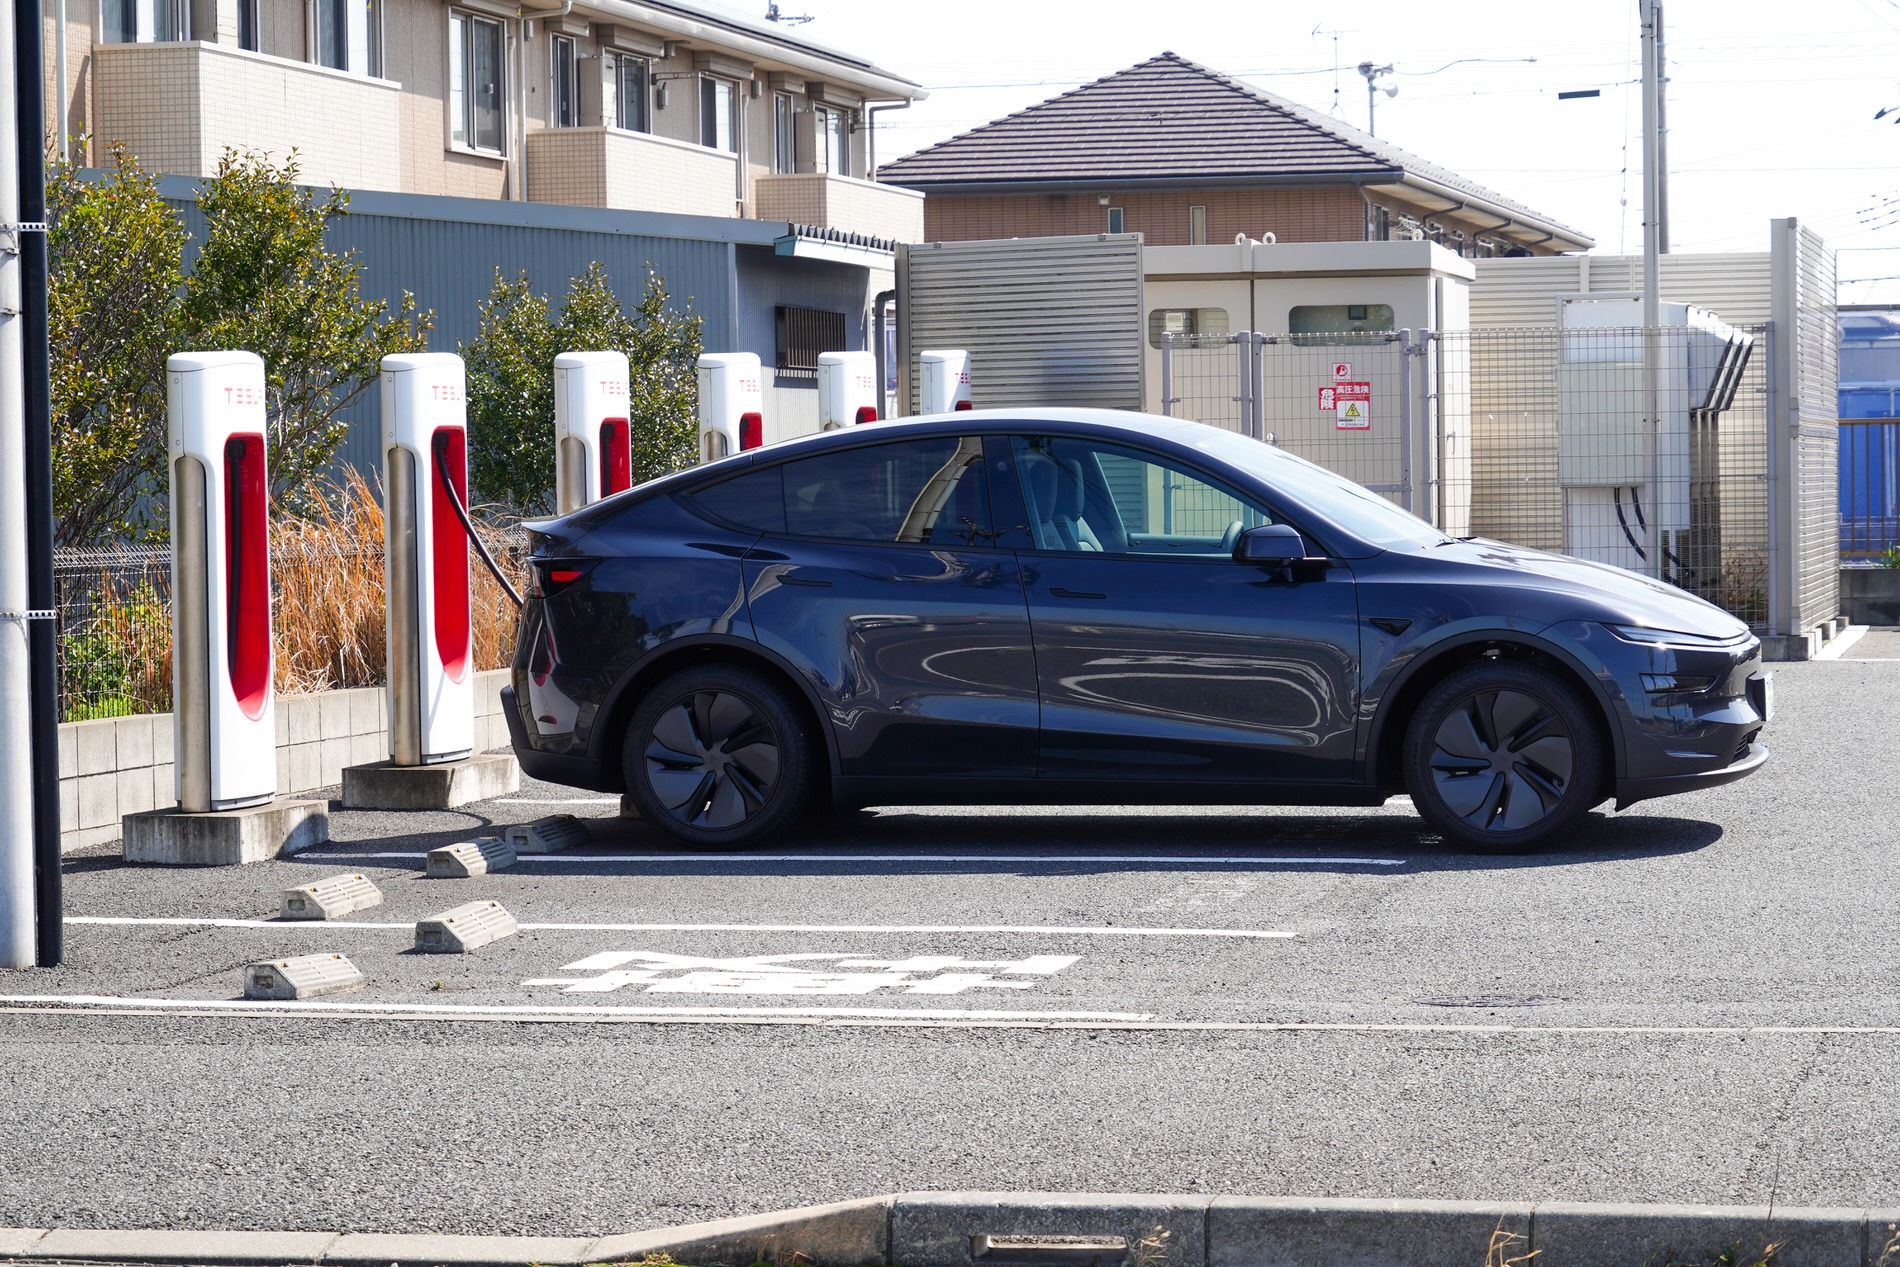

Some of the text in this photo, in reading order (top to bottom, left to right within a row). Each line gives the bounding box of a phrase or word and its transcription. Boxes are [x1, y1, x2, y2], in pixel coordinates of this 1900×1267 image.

[1336, 385, 1370, 394] 高圧危険
[1320, 388, 1335, 410] 危険
